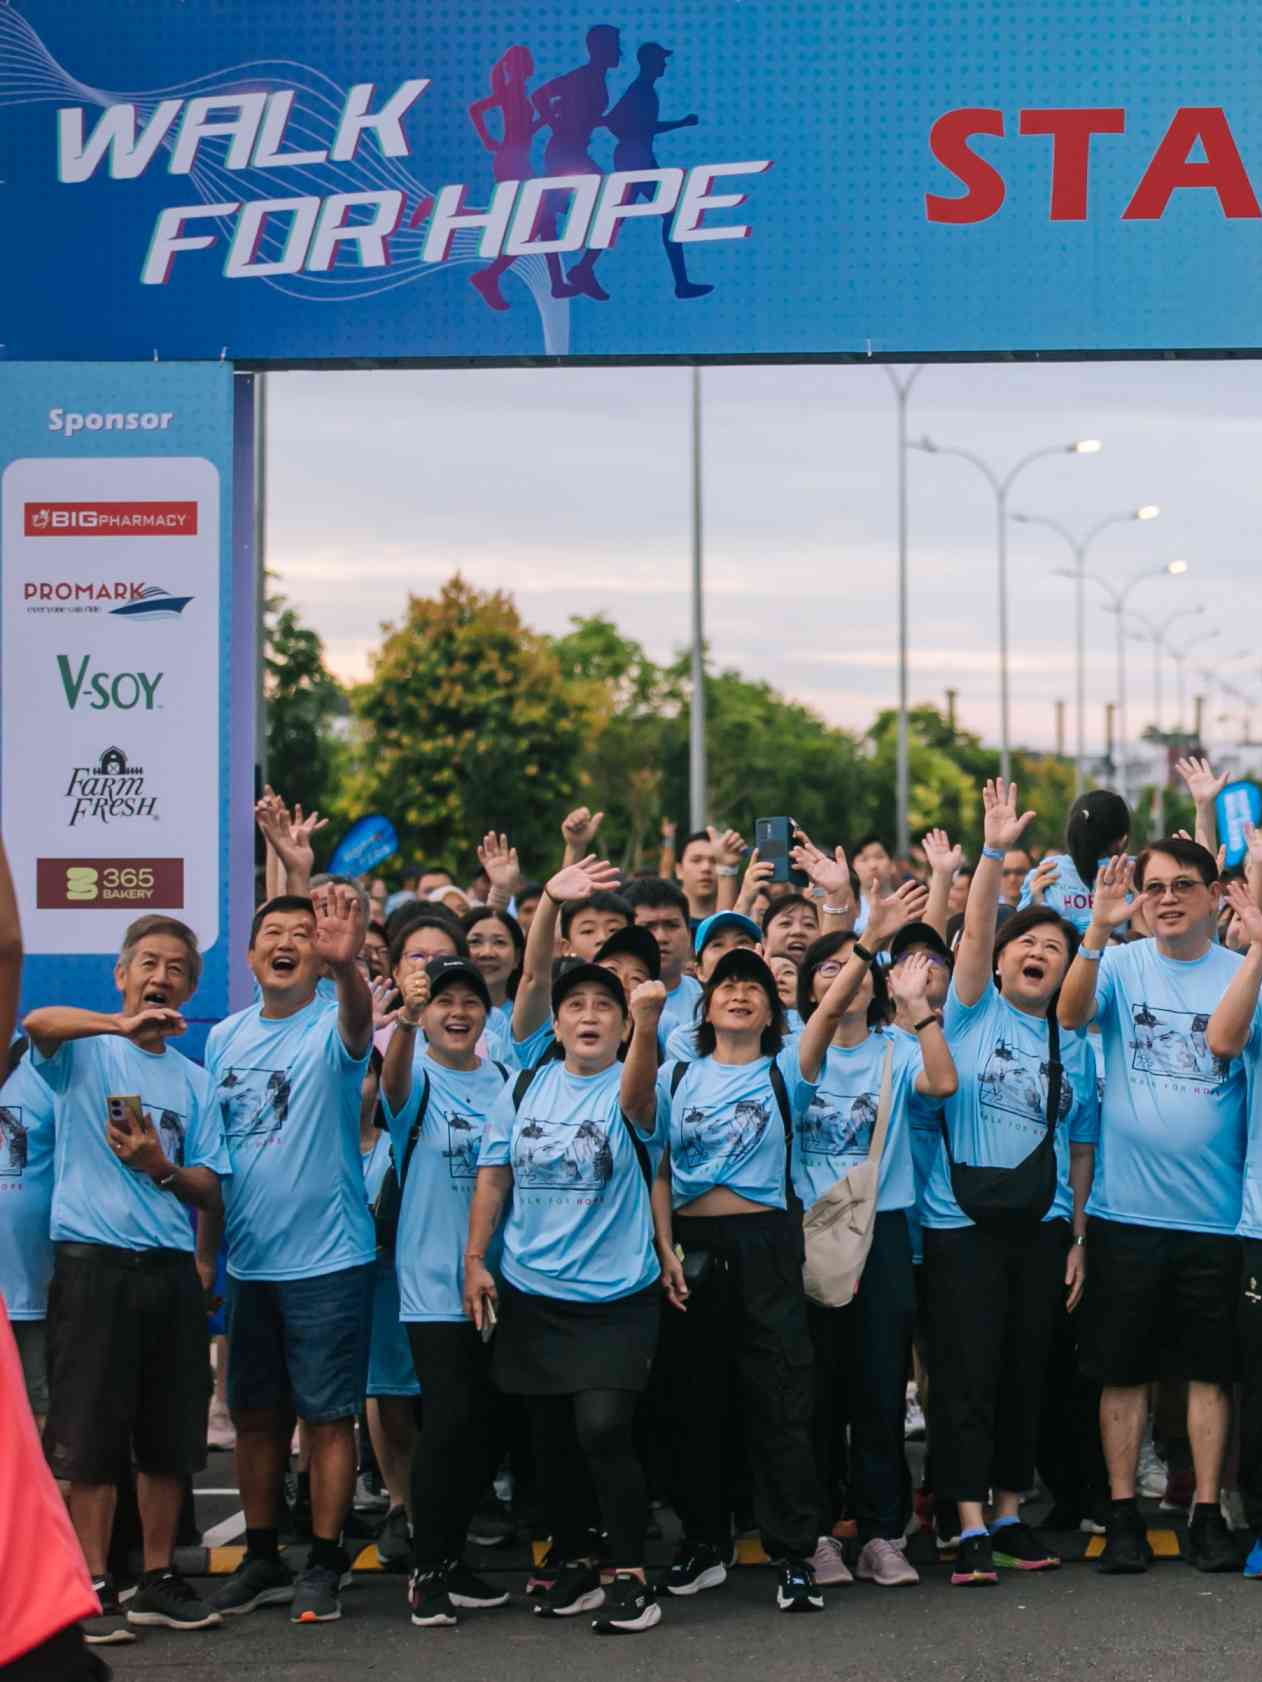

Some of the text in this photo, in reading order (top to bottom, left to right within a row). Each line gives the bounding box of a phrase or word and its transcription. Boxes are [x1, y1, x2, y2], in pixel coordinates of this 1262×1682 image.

[58, 79, 431, 183] WALK
[140, 160, 776, 284] FOR HOPE
[48, 408, 174, 437] Sponsor
[24, 582, 146, 600] PROMARK
[56, 654, 164, 711] V-SOY
[103, 868, 154, 888] 365
[103, 889, 154, 899] BAKERY
